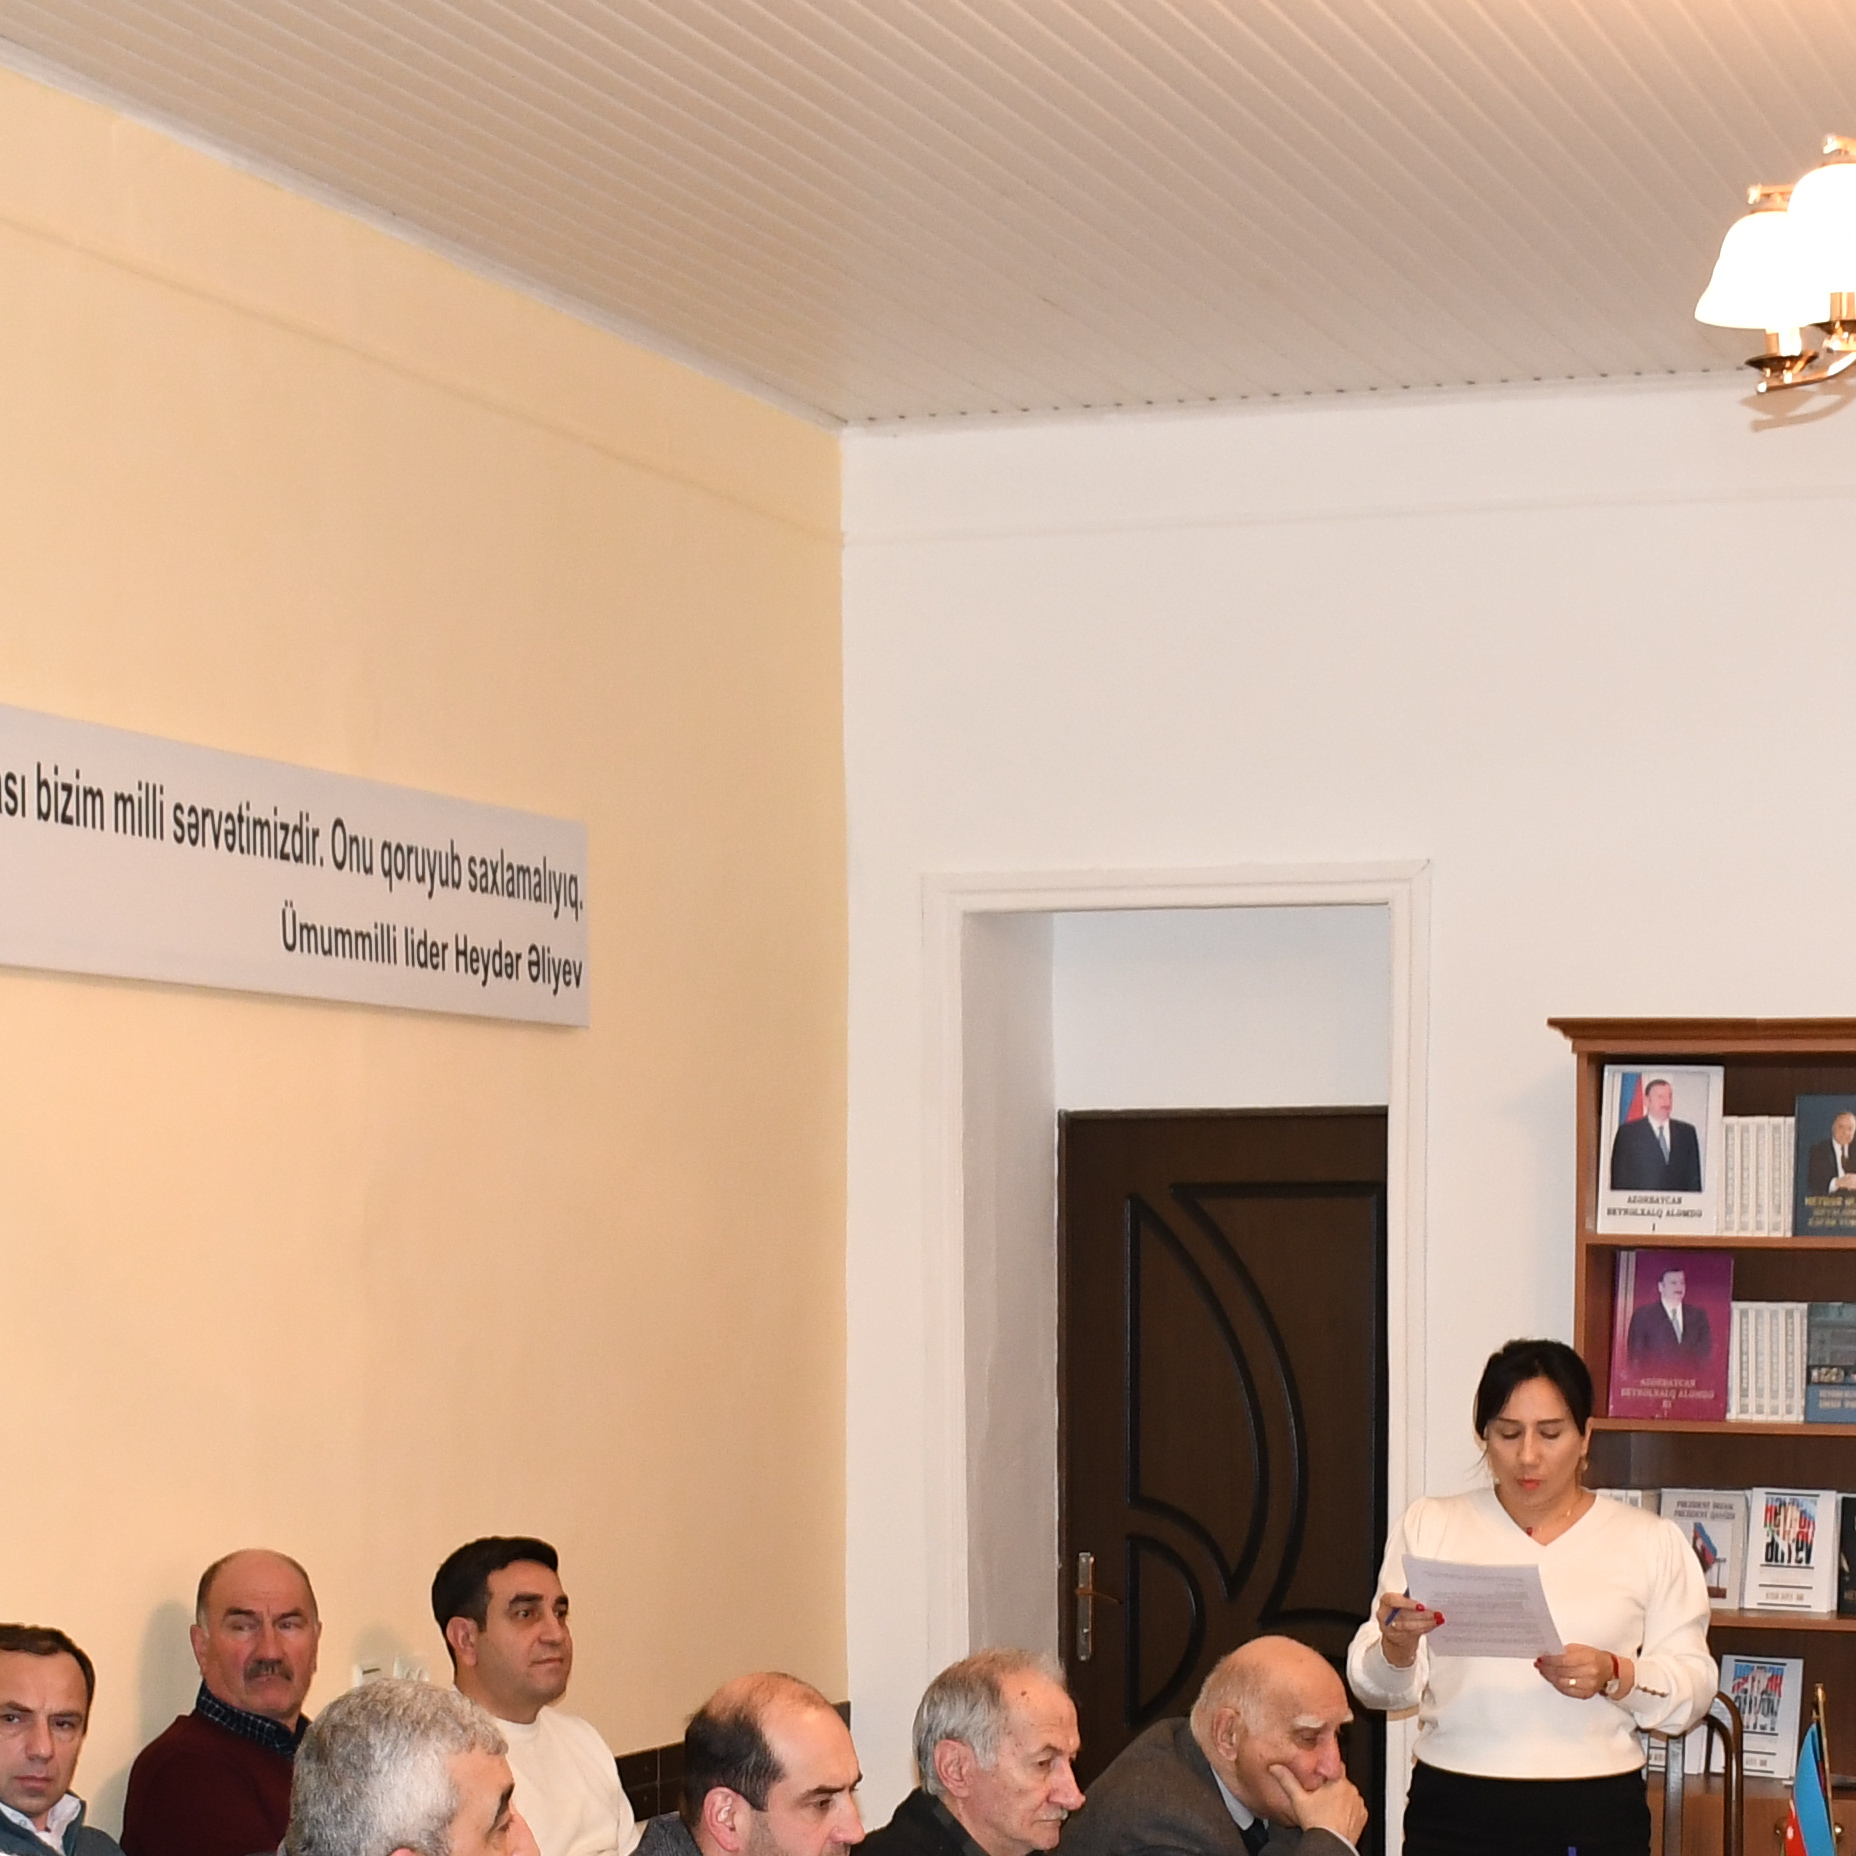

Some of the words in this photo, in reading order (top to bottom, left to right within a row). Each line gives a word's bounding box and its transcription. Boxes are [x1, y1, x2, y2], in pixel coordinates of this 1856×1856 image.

[36, 762, 105, 831] bizim
[114, 781, 164, 840] milli
[173, 802, 324, 867] sərvətimizdir.
[331, 818, 373, 875] Onu
[380, 840, 462, 899] qoruyub
[468, 849, 583, 921] saxlamalıyıq.
[282, 909, 397, 965] Ümummilli
[404, 927, 449, 971] lider
[455, 934, 522, 987] Heydər
[527, 944, 583, 996] Əliyev
